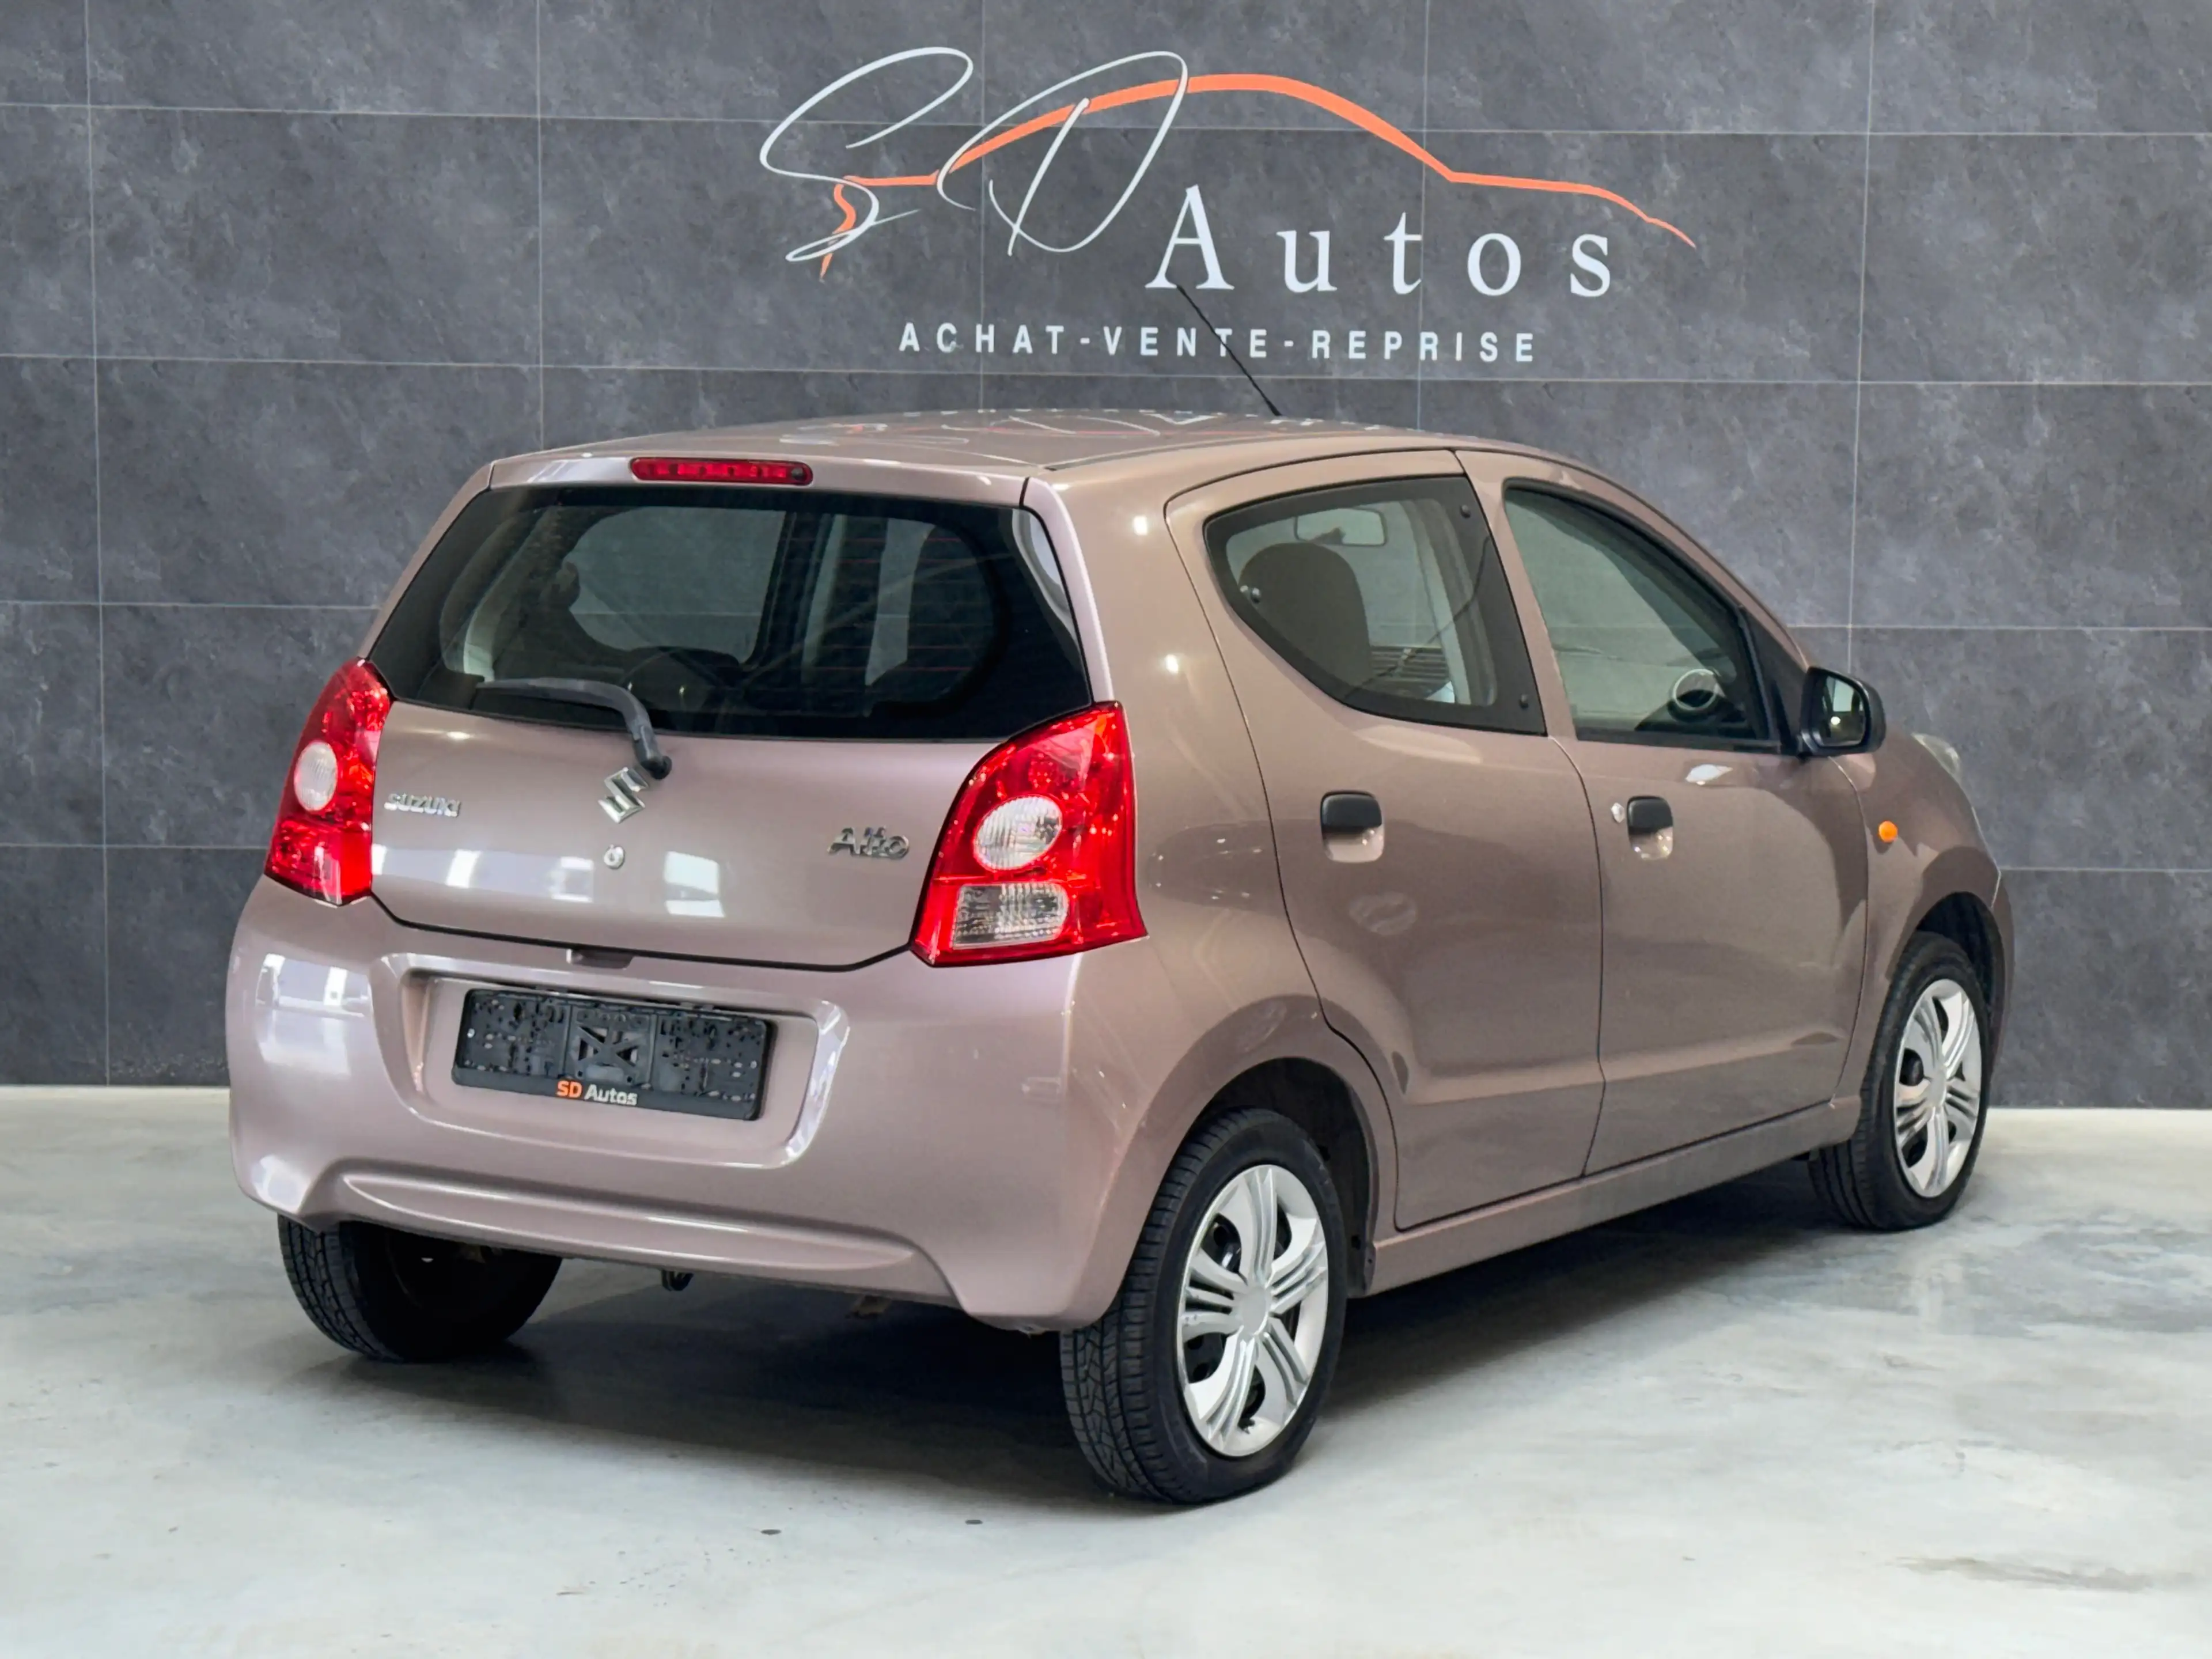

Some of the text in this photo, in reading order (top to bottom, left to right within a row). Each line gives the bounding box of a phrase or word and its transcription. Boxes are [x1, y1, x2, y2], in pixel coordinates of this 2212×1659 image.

[1145, 184, 1612, 298] Autos
[899, 323, 1536, 363] ACHAT-VENTE-REPRISE
[384, 793, 461, 817] SUZUKI
[827, 826, 910, 859] Alto
[556, 1080, 638, 1106] SD Autos
